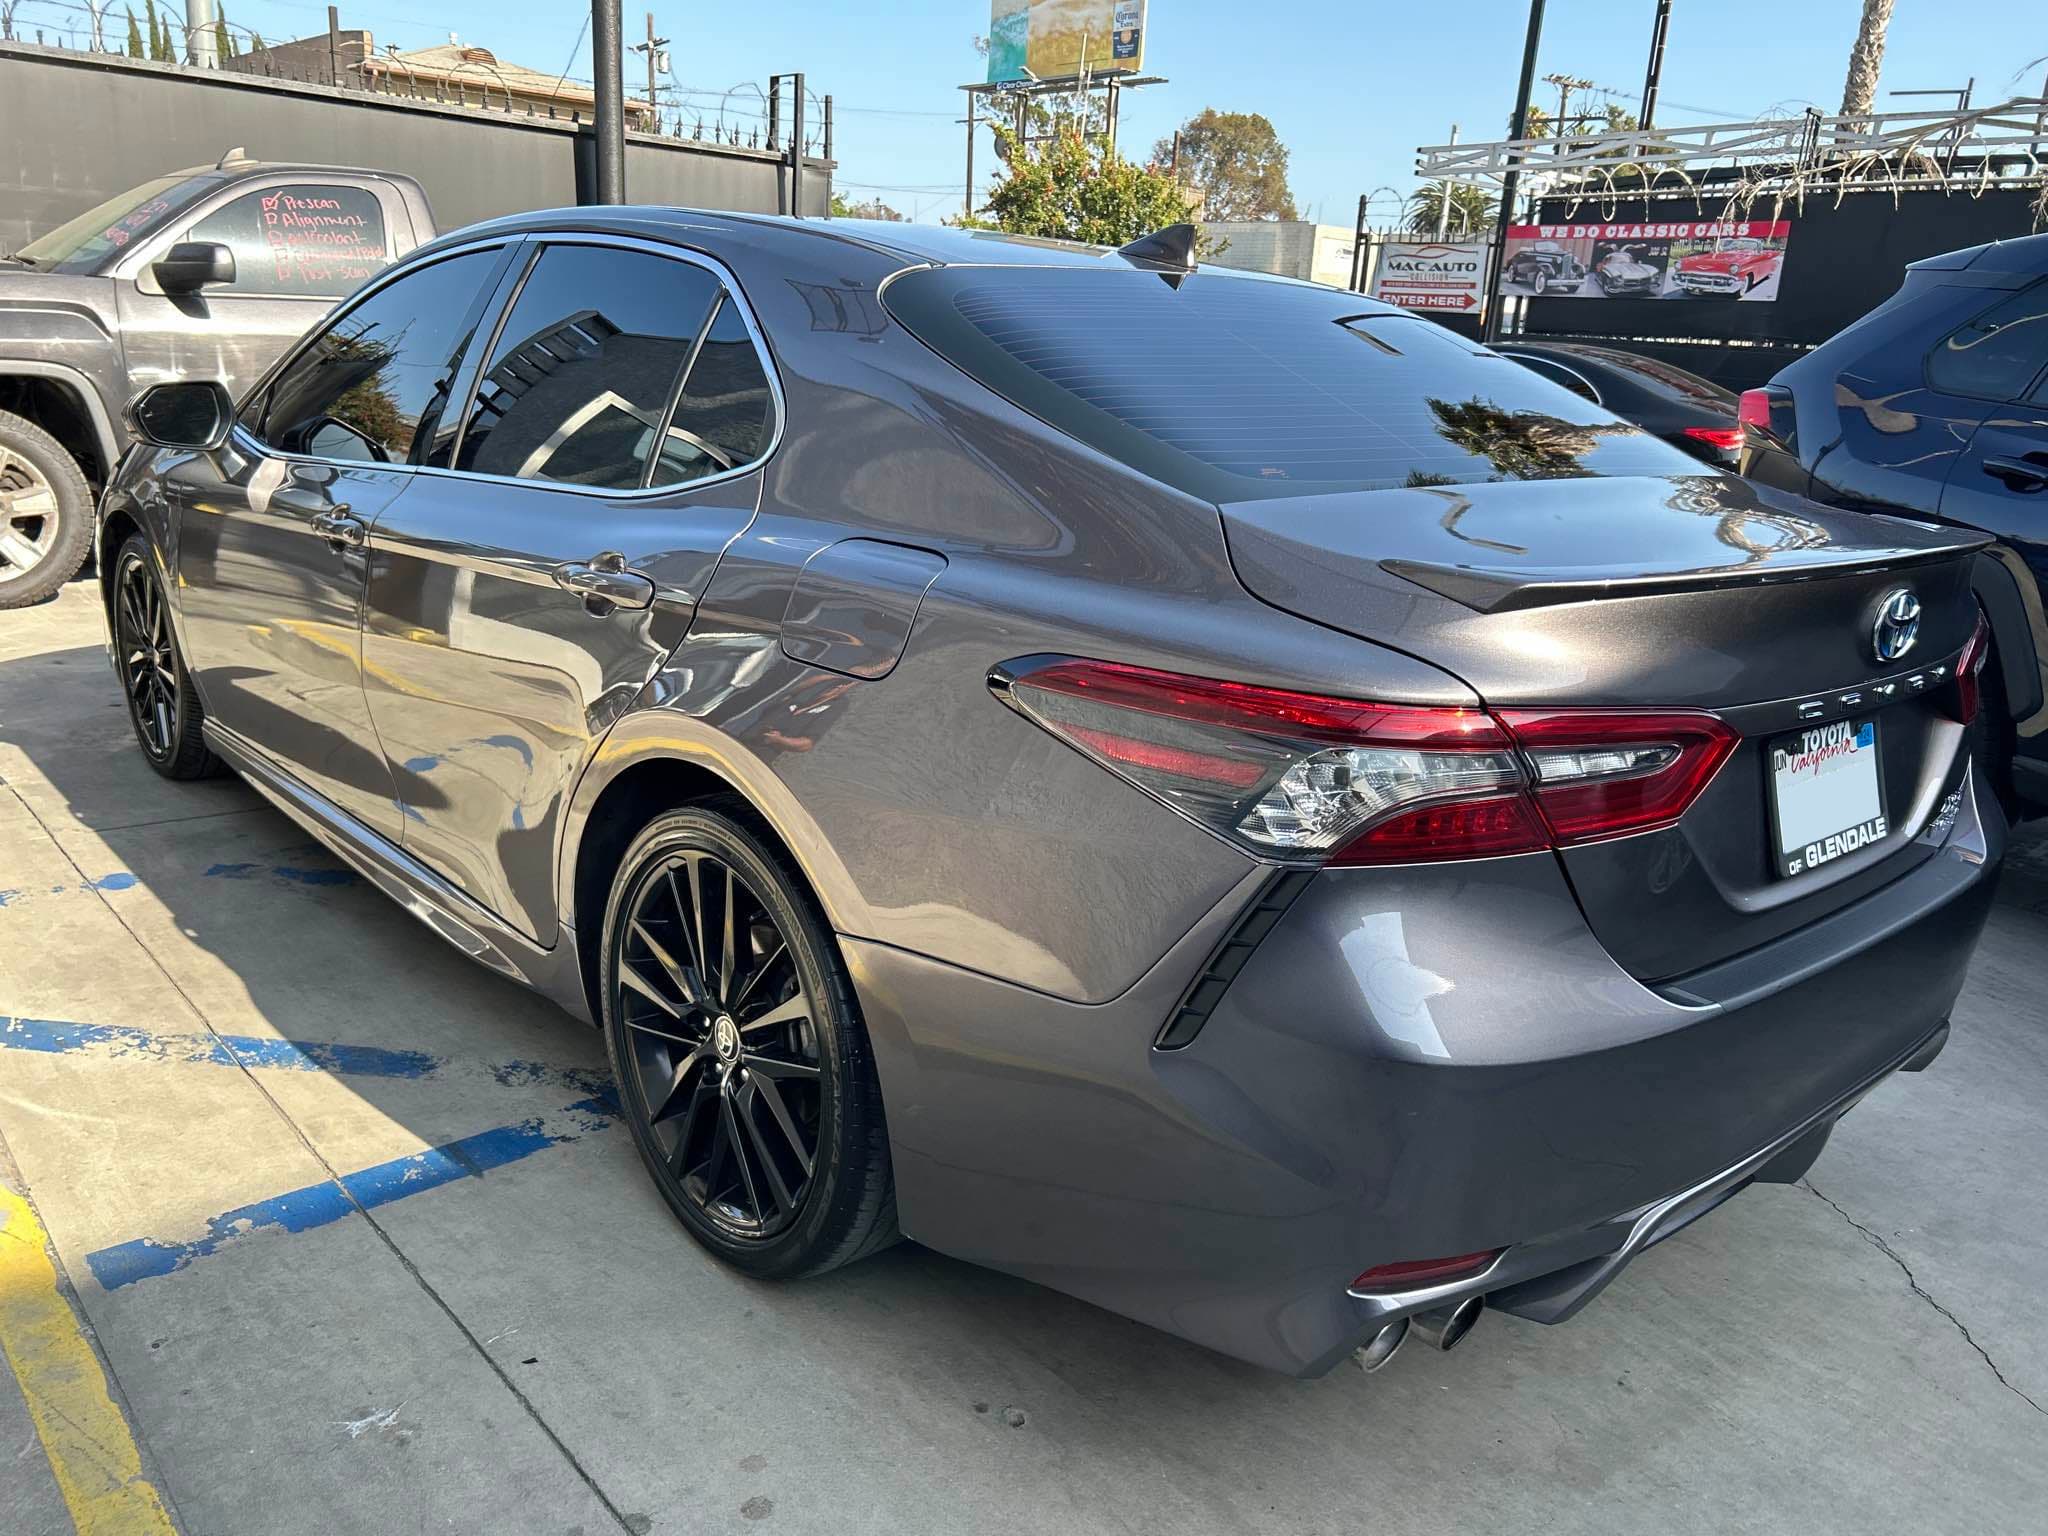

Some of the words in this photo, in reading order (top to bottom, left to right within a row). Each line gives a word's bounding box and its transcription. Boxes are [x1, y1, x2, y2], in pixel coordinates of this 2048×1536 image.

[1115, 11, 1138, 23] Corona
[282, 212, 368, 232] Alignment
[1539, 226, 1568, 238] WE
[1573, 226, 1600, 238] DO
[1604, 224, 1690, 238] CLASSIC
[1694, 223, 1750, 237] CARS
[1388, 262, 1425, 271] MAC
[1428, 262, 1477, 272] AUTO
[1409, 272, 1449, 281] COLLISION
[1383, 294, 1426, 306] ENTER
[1428, 295, 1466, 306] HERE
[1802, 720, 1851, 753] TOYOTA
[1791, 736, 1859, 776] California
[1788, 858, 1802, 876] OF
[1805, 817, 1888, 868] GLENDALE
